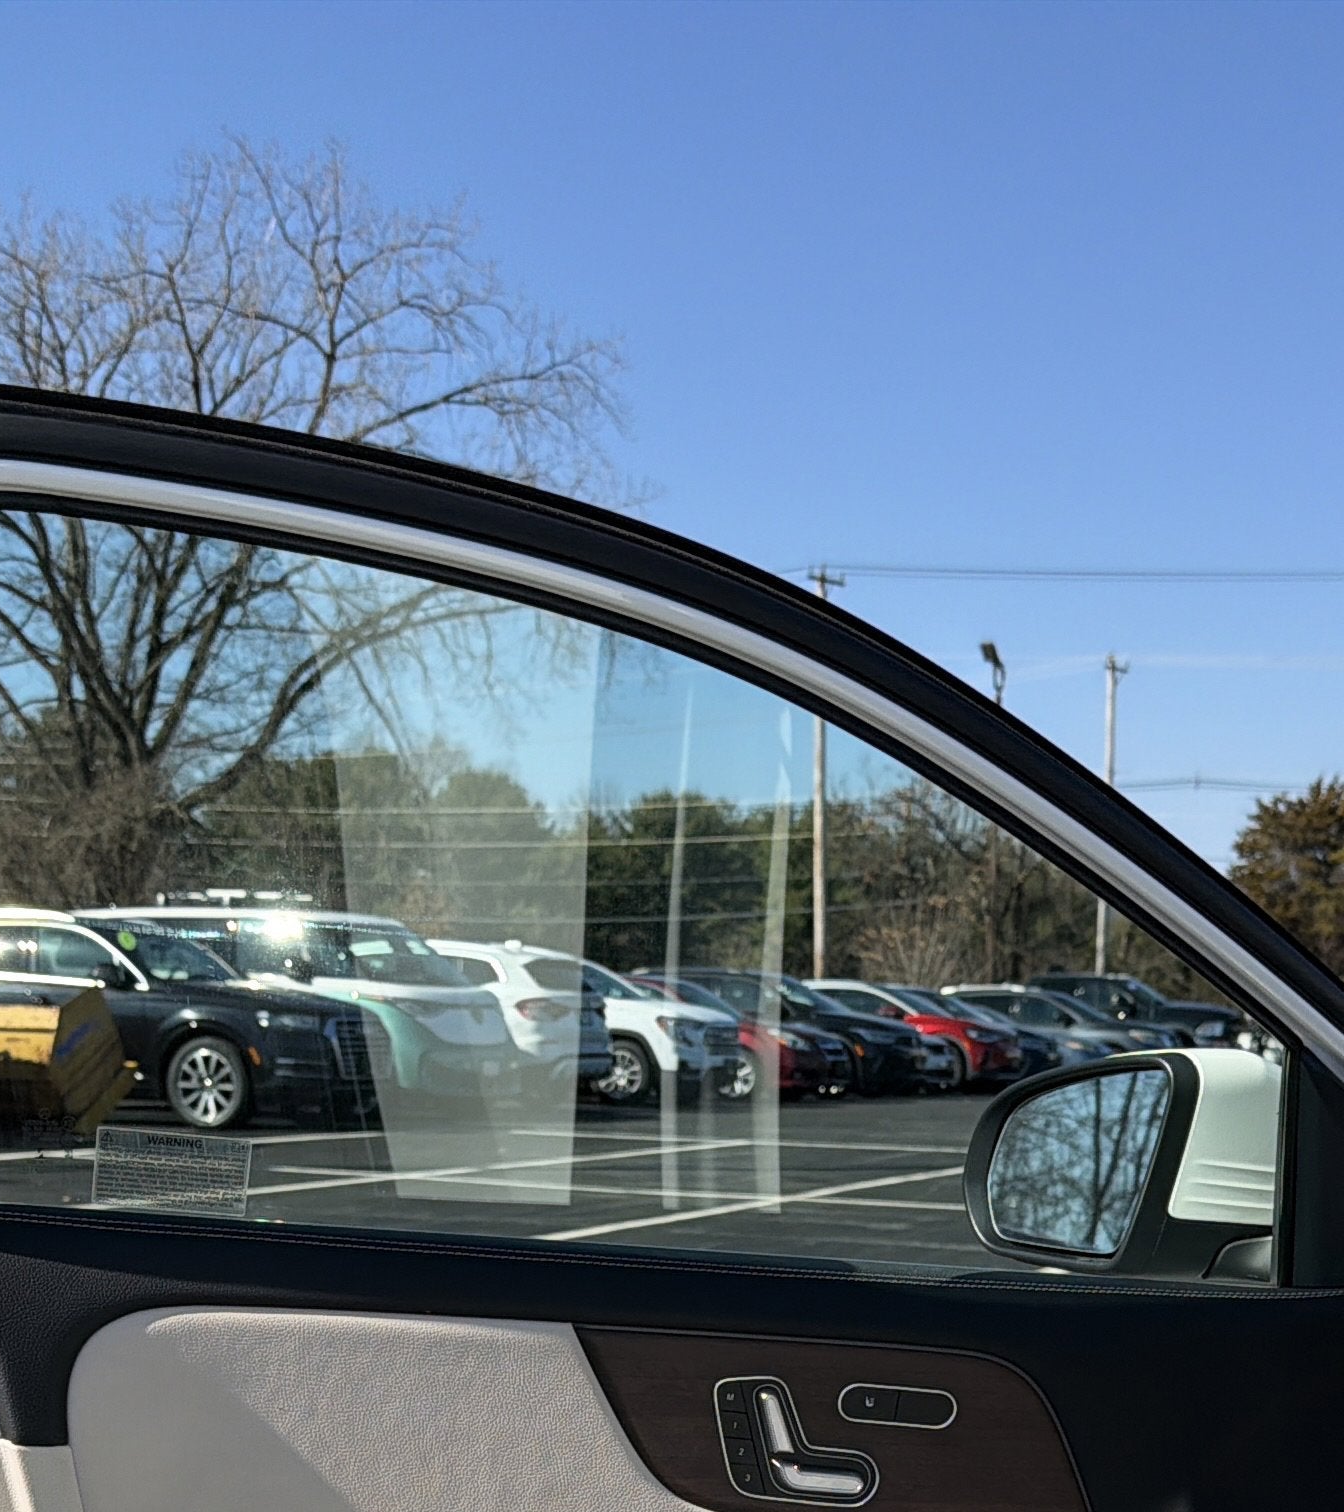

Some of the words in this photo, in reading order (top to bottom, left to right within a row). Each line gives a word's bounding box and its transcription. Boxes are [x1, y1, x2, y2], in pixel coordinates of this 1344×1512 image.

[146, 1135, 204, 1150] WARNING
[726, 1393, 735, 1401] M
[733, 1421, 738, 1429] 1
[738, 1447, 745, 1456] 2
[744, 1474, 751, 1482] 3
